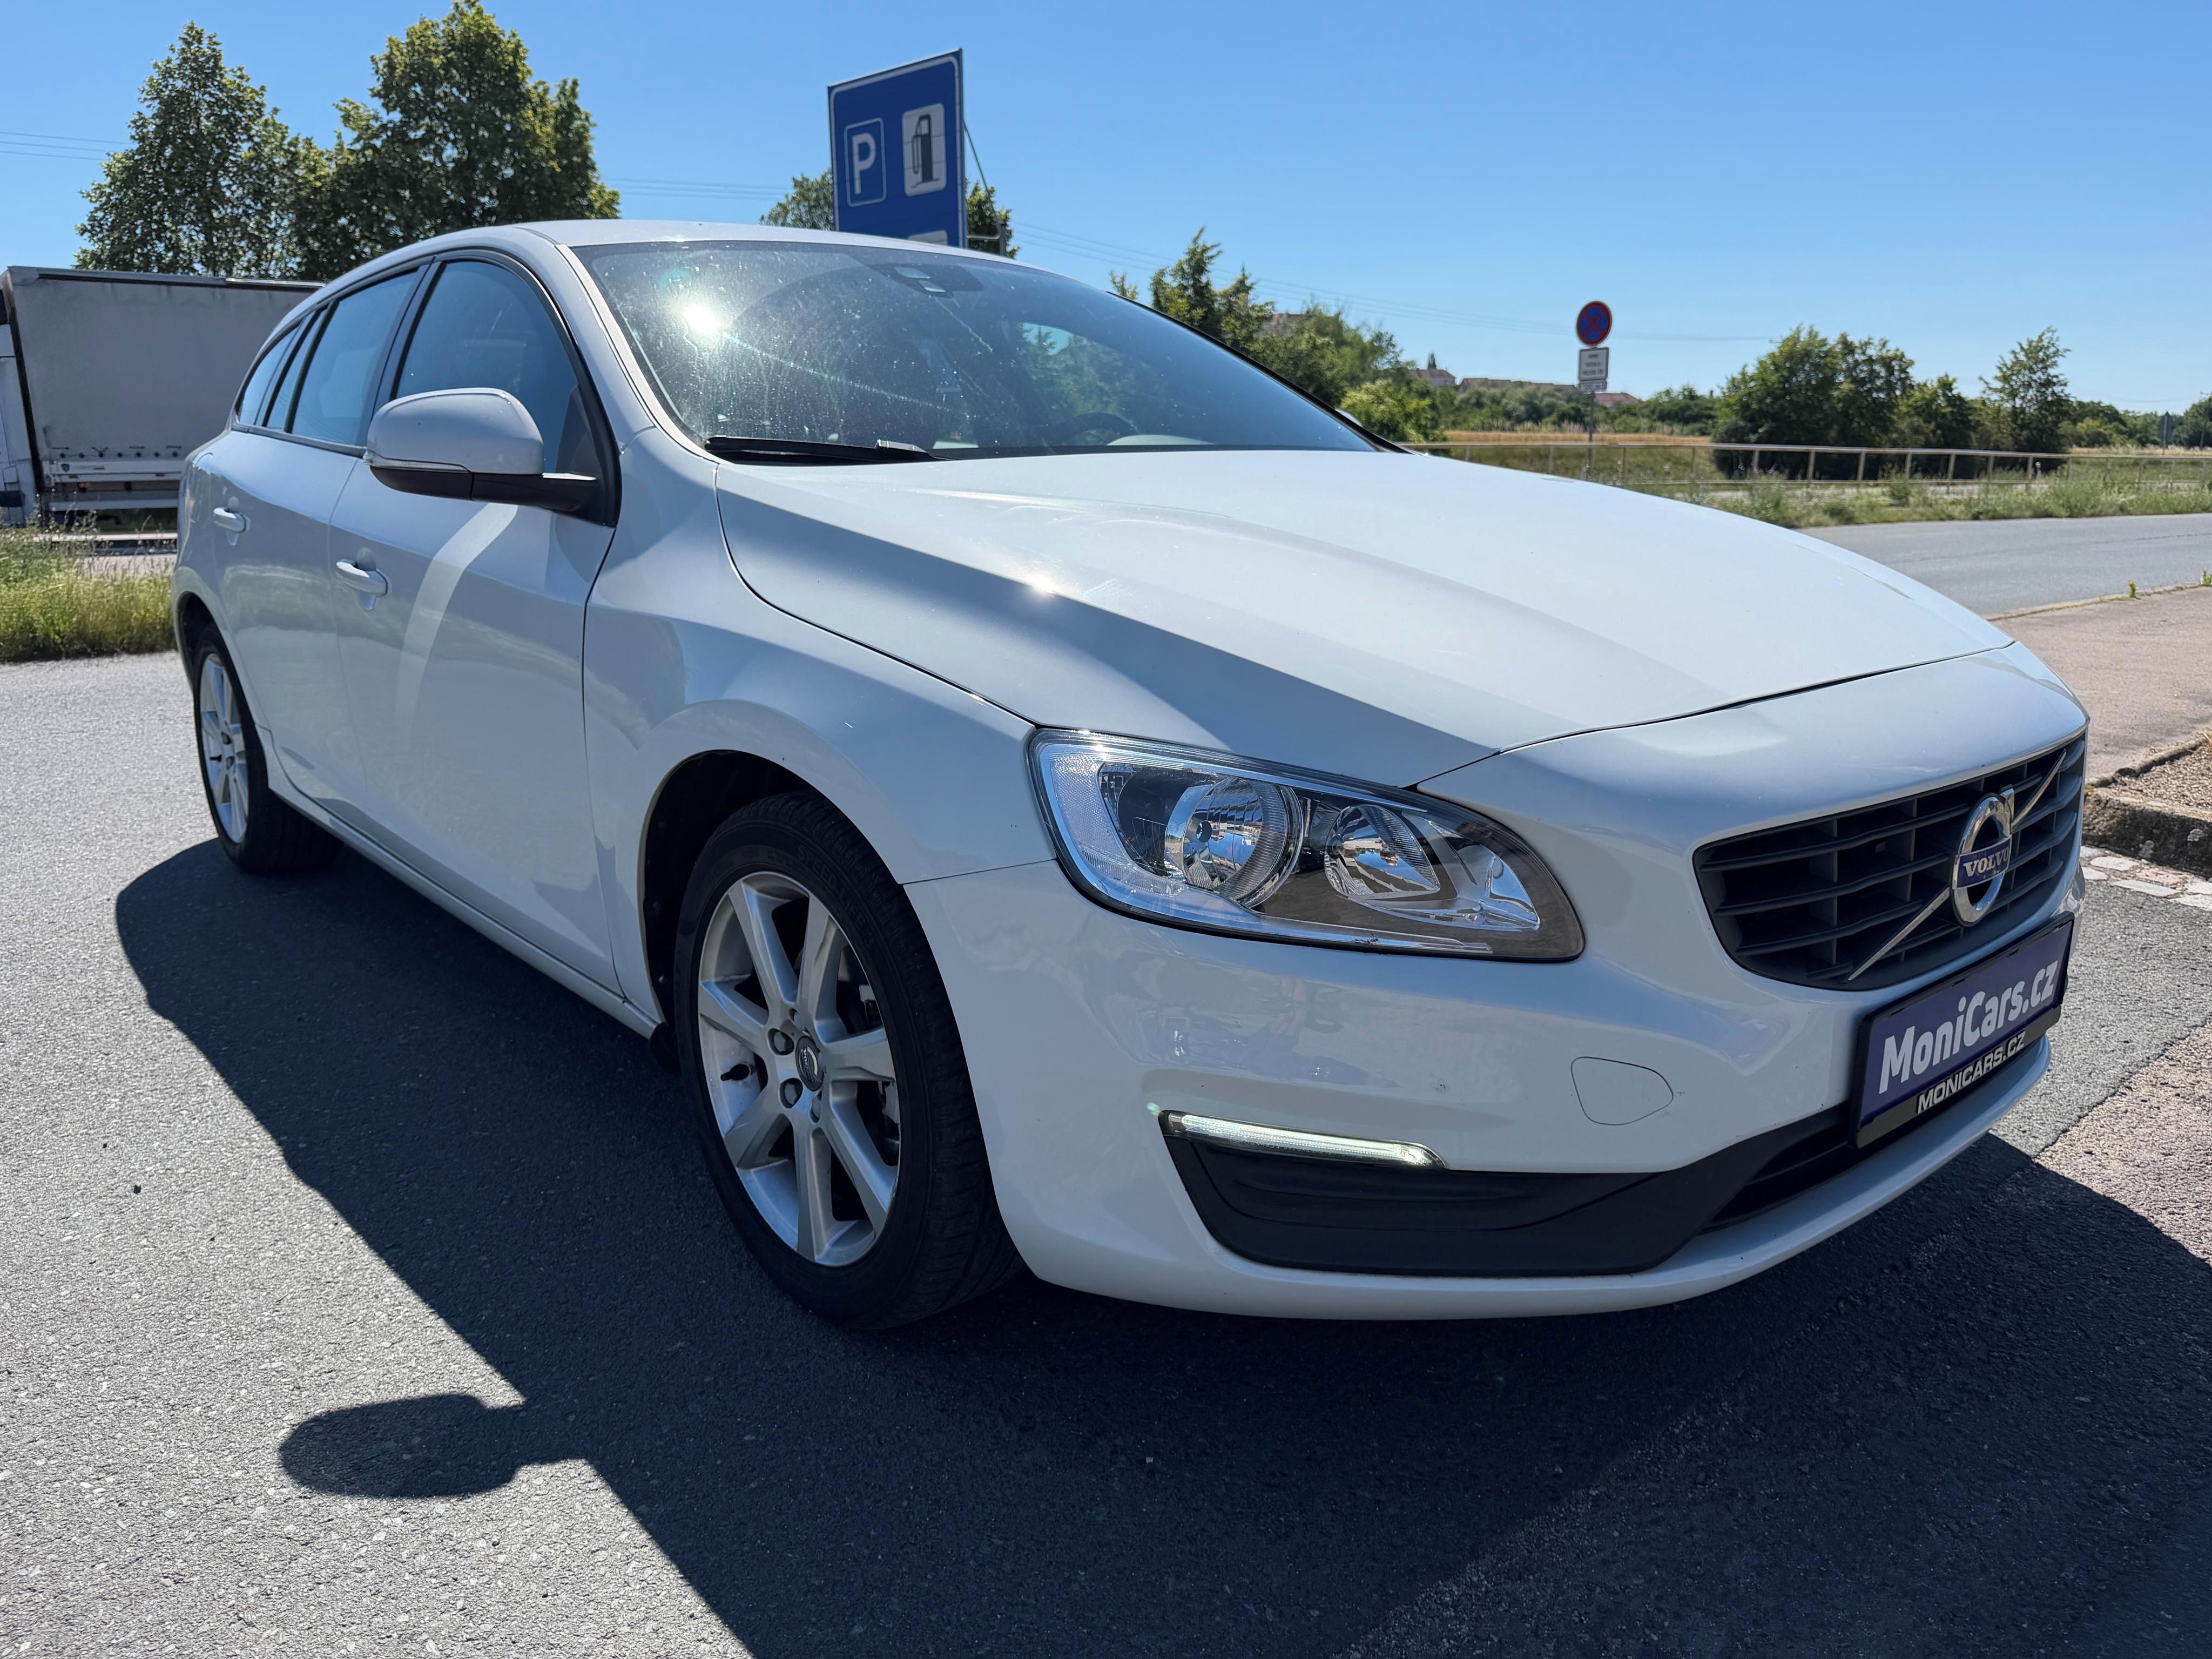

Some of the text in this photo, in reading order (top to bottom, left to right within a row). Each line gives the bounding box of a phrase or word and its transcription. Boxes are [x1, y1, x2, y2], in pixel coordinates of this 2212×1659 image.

[852, 133, 876, 194] P
[1964, 847, 2009, 877] VOLVO
[1879, 961, 2058, 1094] MoniCars.cz
[1918, 1032, 2026, 1114] MONICARS.CZ
